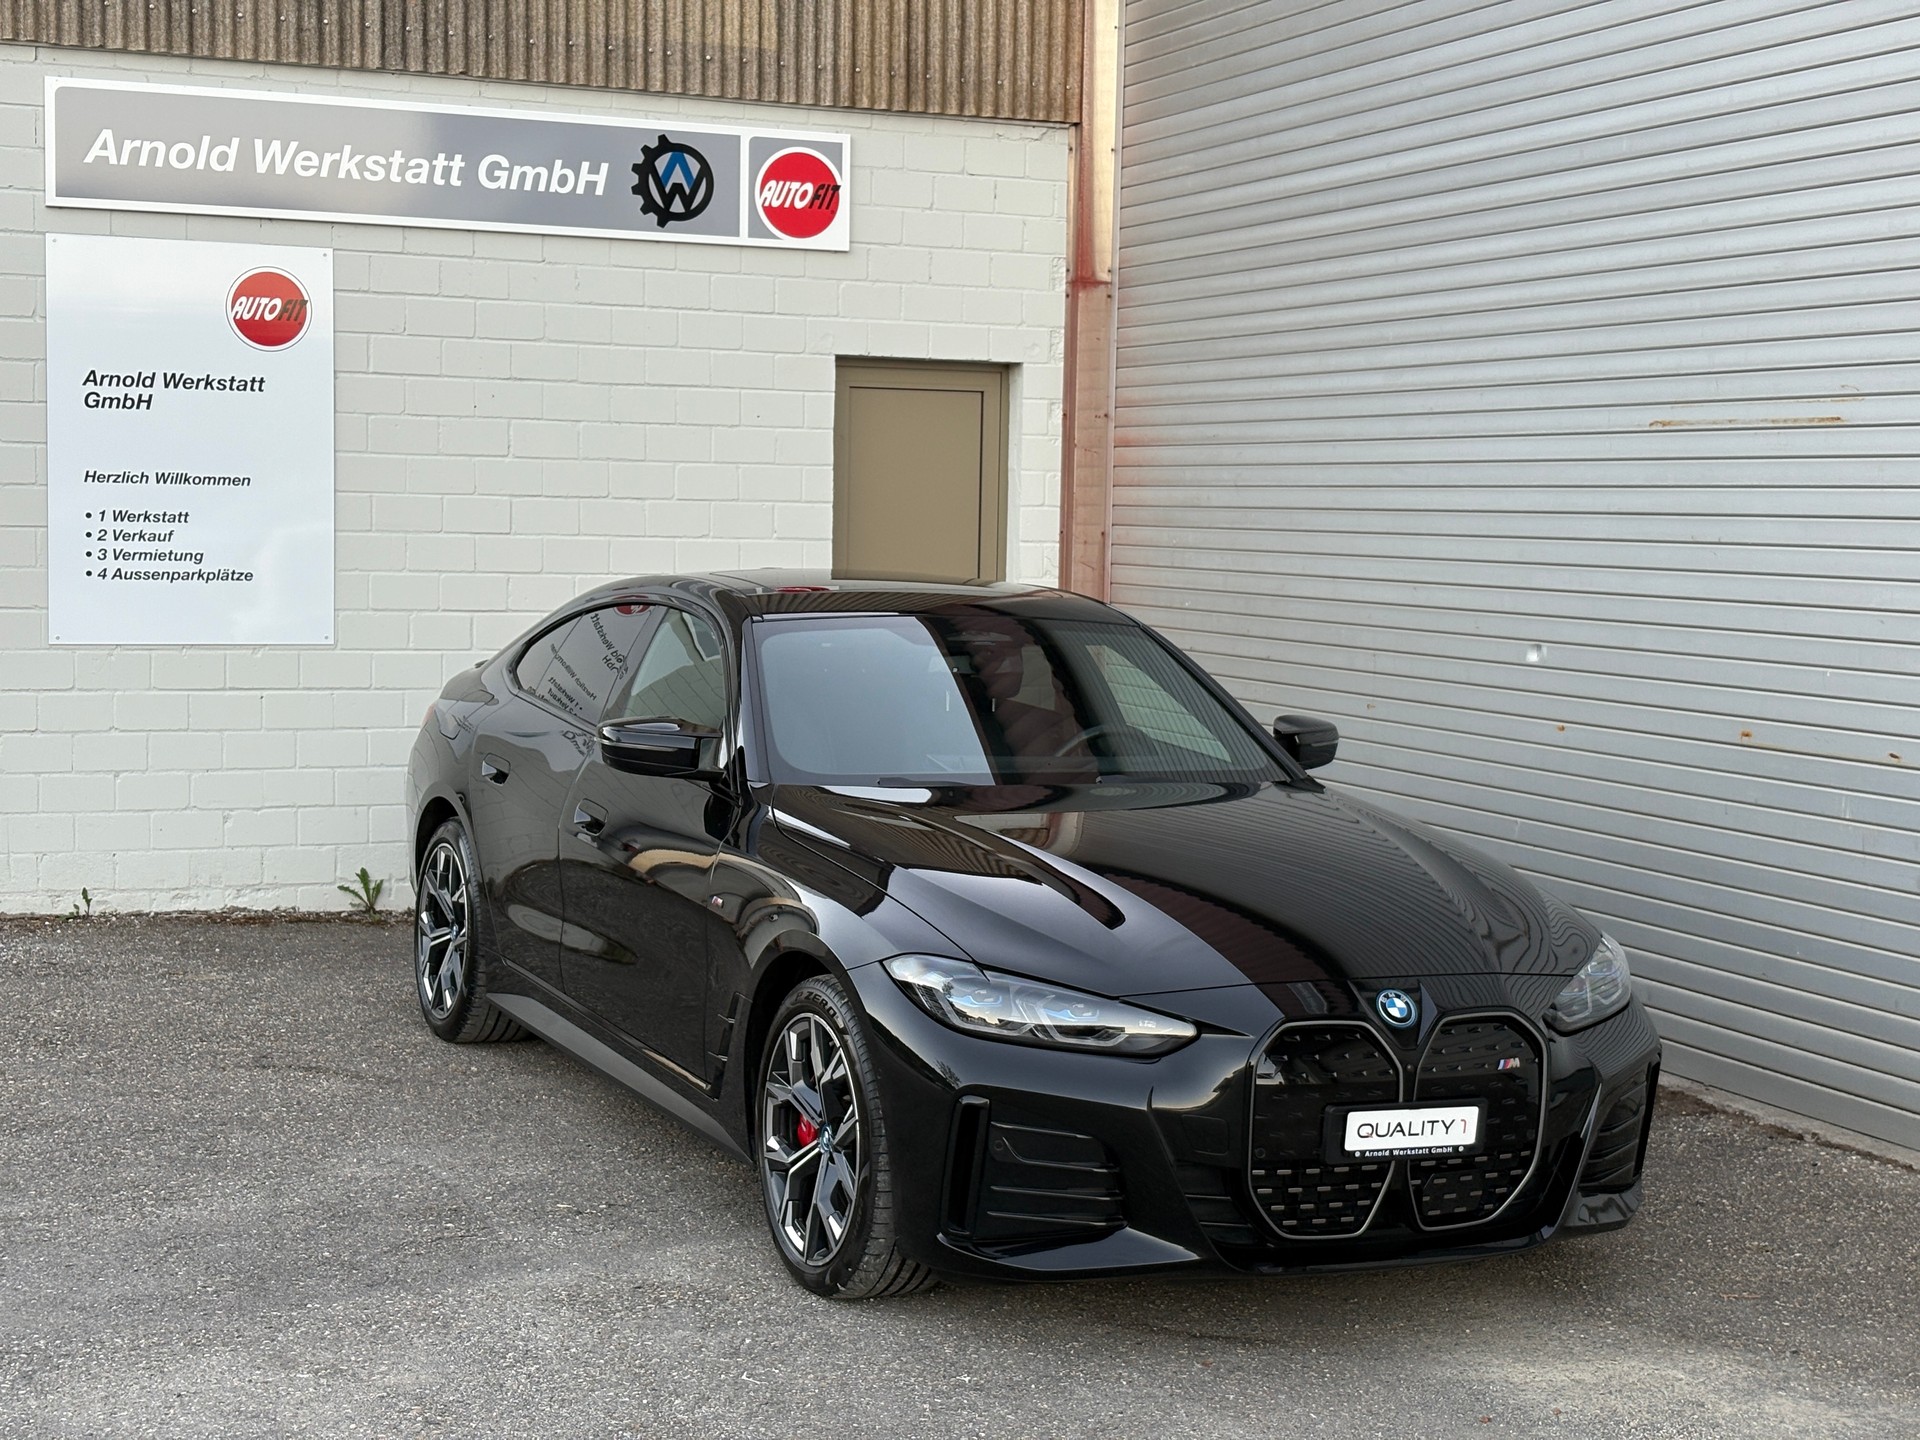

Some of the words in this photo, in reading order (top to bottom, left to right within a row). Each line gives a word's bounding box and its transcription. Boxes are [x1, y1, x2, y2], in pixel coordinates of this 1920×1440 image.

[83, 129, 239, 172] Arnold
[253, 138, 466, 187] Werkstatt
[477, 154, 609, 196] GmbH
[760, 179, 842, 211] AUTOFIT
[231, 296, 309, 322] AUTOFIT
[81, 369, 157, 389] Arnold
[162, 372, 266, 393] Werkstatt
[83, 391, 154, 411] GmbH
[83, 470, 150, 485] Herzlich
[155, 471, 251, 487] Willkommen
[98, 509, 106, 522] 1
[112, 509, 190, 524] Werkstatt
[96, 528, 108, 542] 2
[112, 528, 175, 543] Verkauf
[97, 547, 108, 561] 3
[112, 548, 205, 565] Vermietung
[97, 567, 108, 580] 4
[110, 567, 254, 584] Aussenparkplätze
[1356, 1119, 1456, 1139] QUALITY
[1364, 1149, 1389, 1157] Arnold
[1392, 1147, 1429, 1156] Werkstatt
[1431, 1146, 1453, 1154] GmbH
